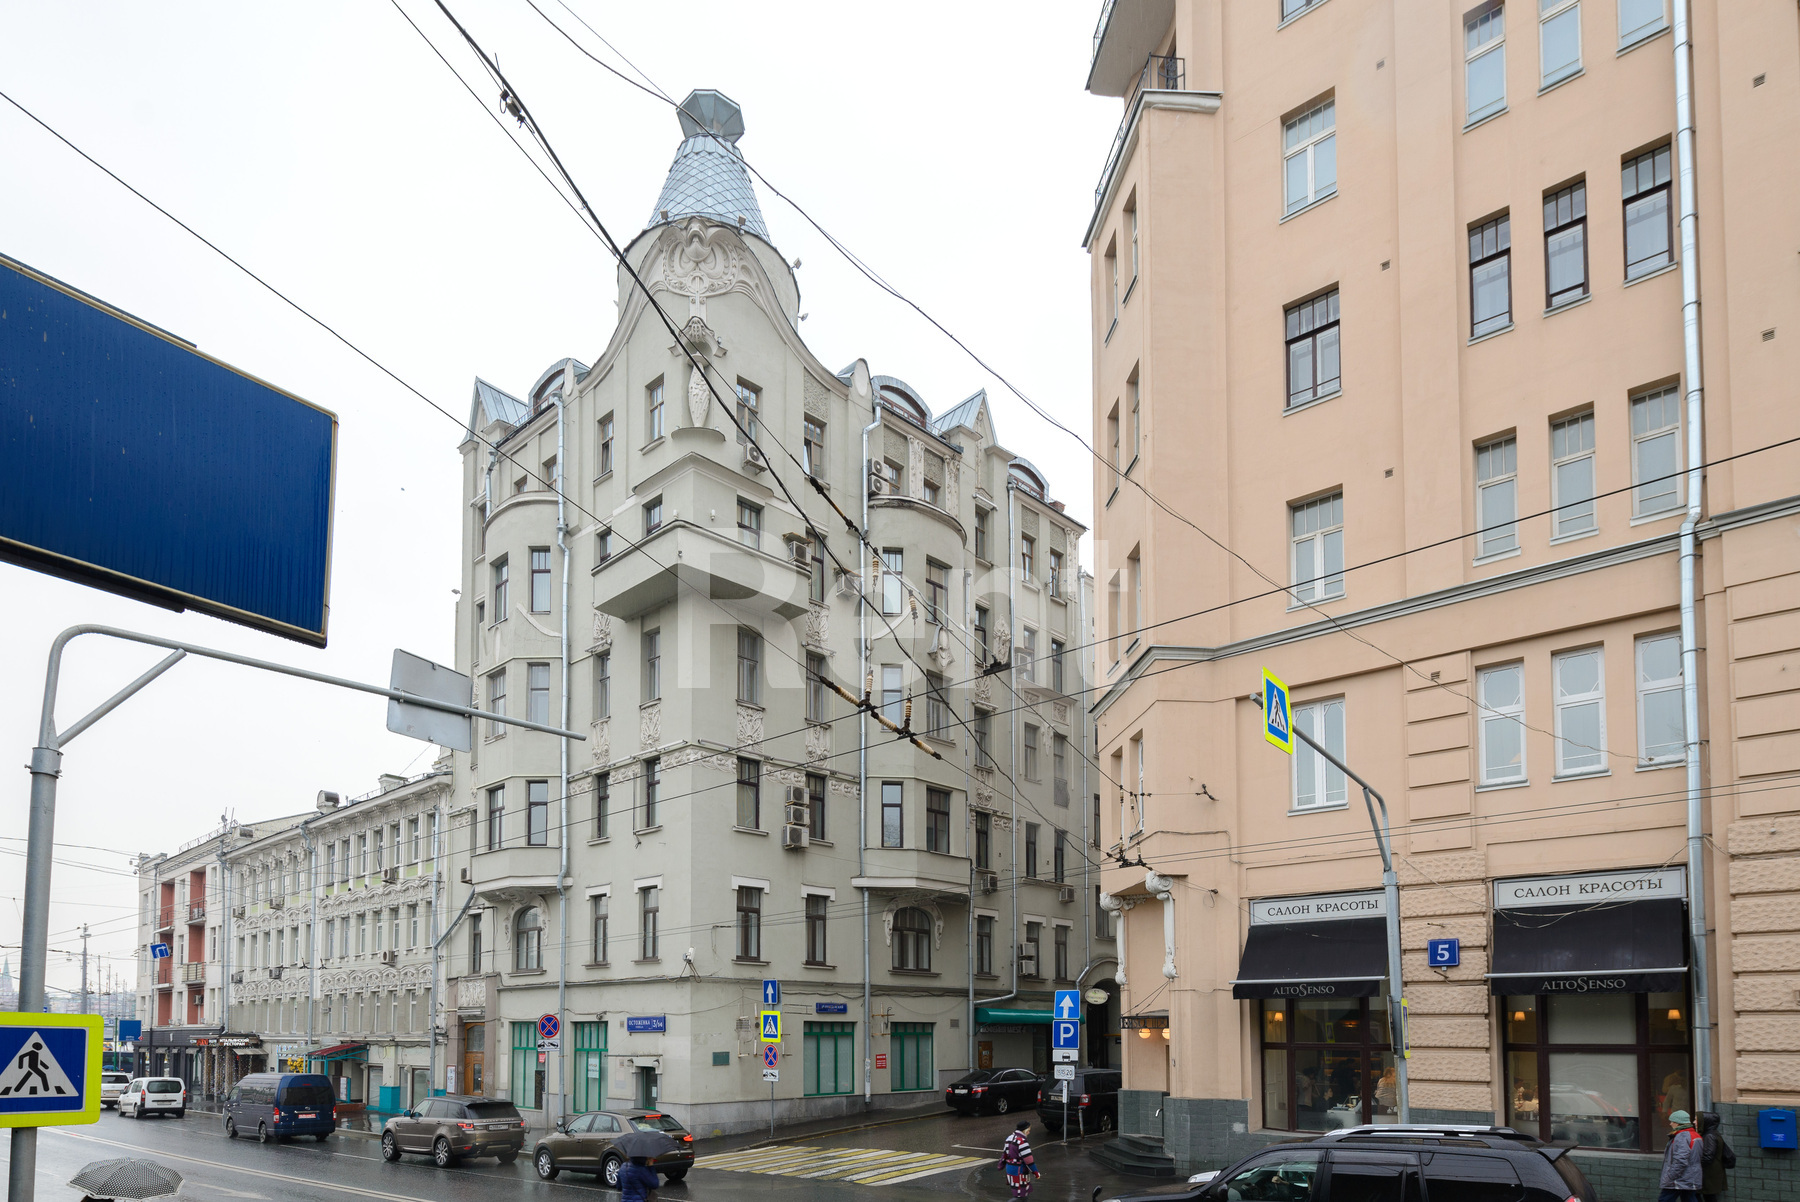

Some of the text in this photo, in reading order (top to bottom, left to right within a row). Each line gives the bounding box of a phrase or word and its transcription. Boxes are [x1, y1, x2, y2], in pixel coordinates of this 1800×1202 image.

[1514, 878, 1663, 899] САЛОН КРАСОТЫ
[1267, 899, 1379, 917] САЛОН КРАСОТЫ
[1436, 943, 1450, 961] 5
[1060, 1023, 1074, 1045] P
